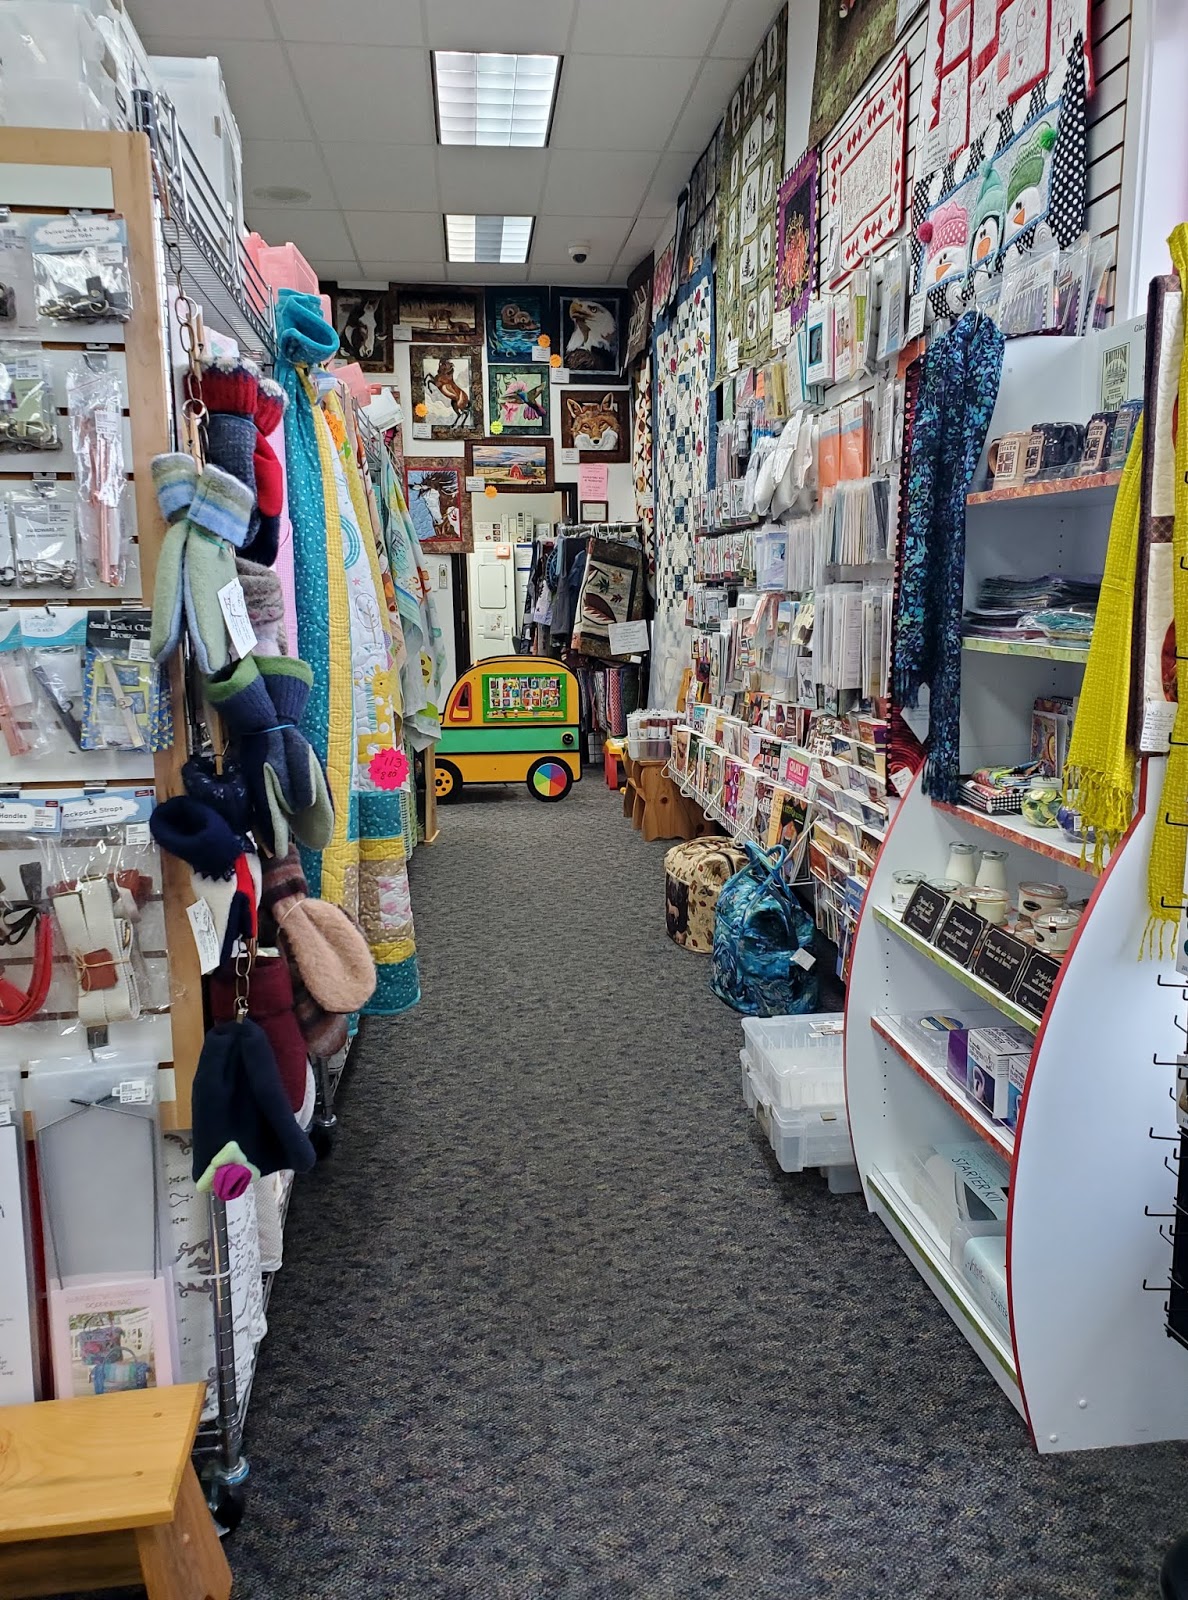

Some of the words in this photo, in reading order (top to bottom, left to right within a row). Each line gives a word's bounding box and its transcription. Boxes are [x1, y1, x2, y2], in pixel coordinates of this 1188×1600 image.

[134, 624, 152, 632] Clas
[789, 760, 806, 777] QUILT
[62, 808, 97, 819] ackpack
[99, 804, 124, 814] Straps
[951, 1157, 991, 1190] STARTER
[982, 1191, 1005, 1203] KIT
